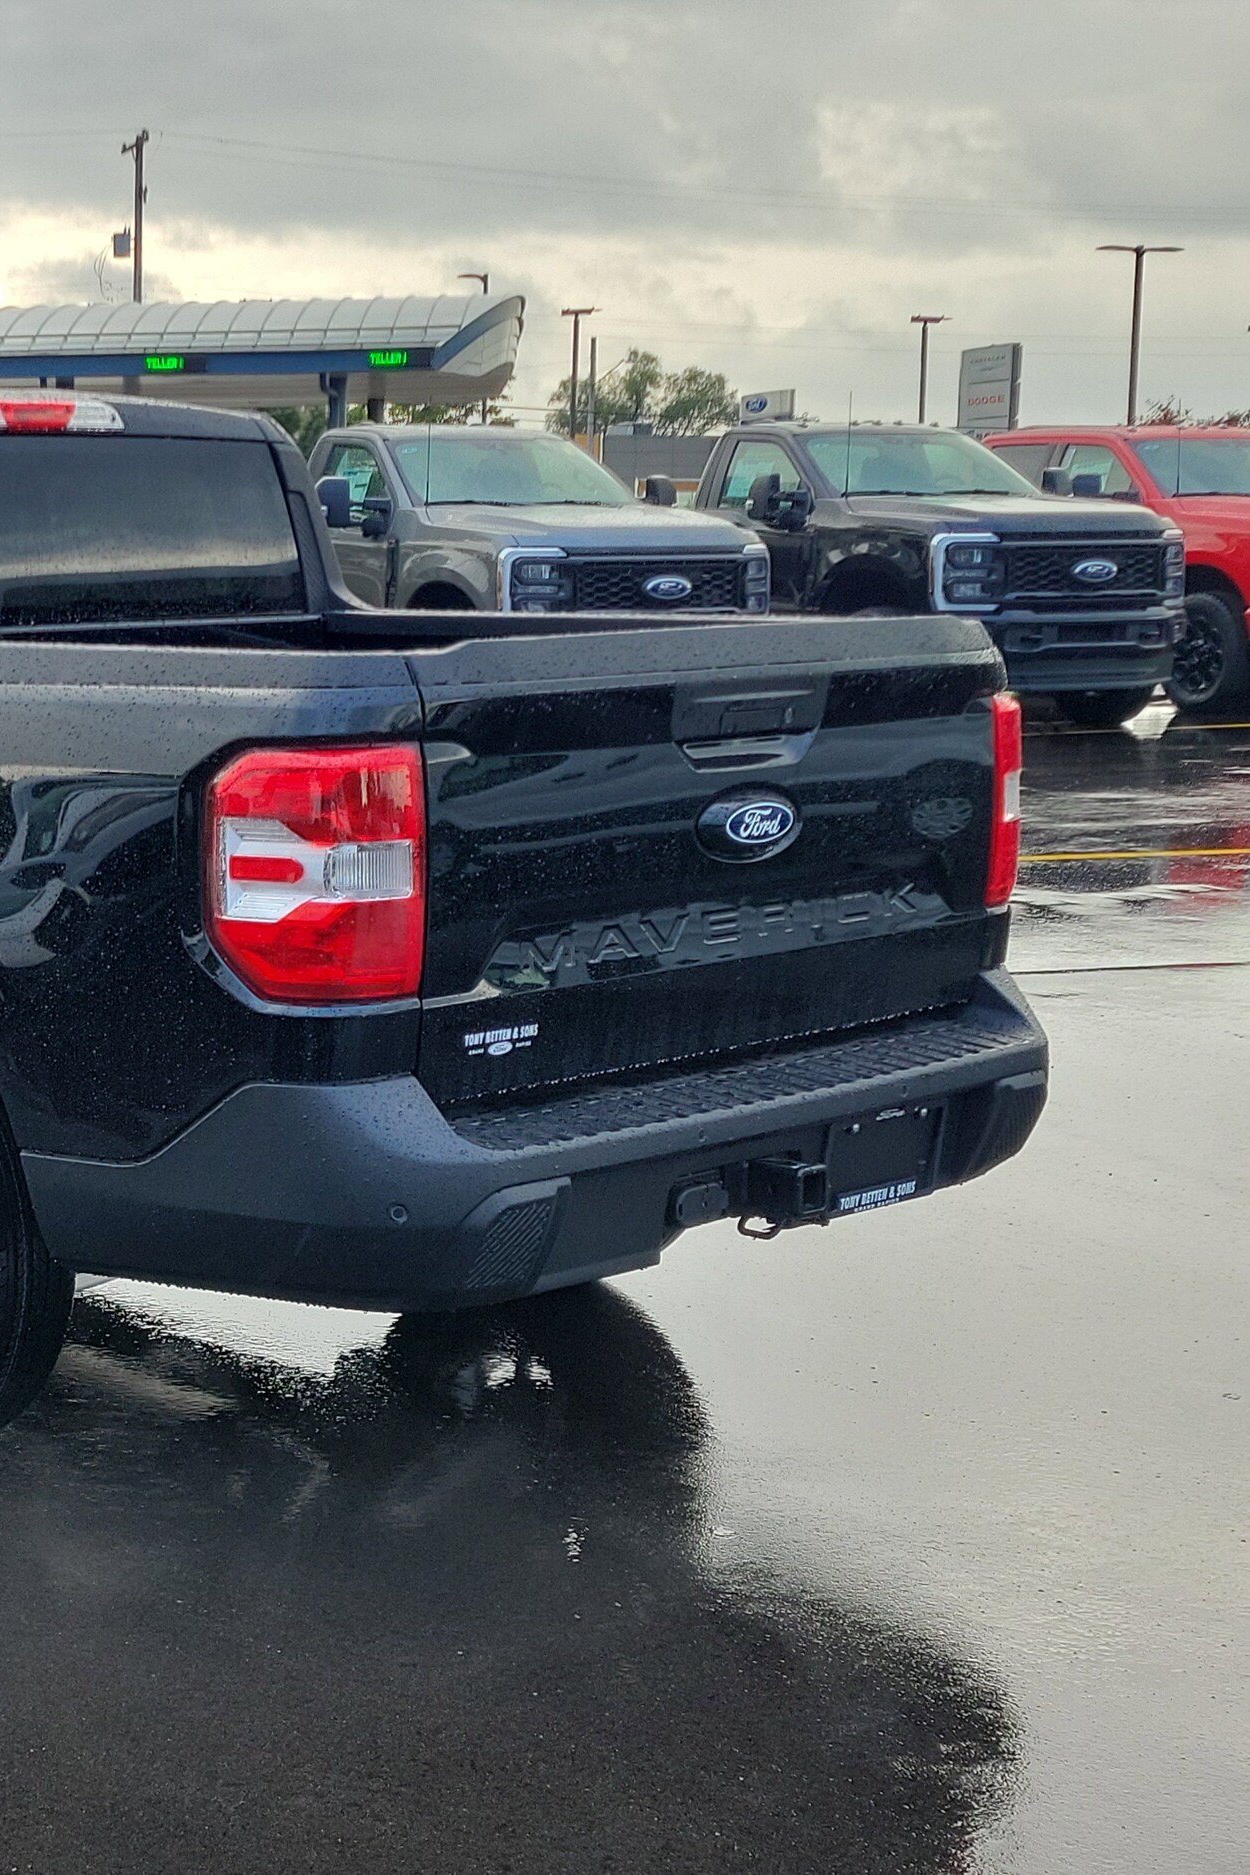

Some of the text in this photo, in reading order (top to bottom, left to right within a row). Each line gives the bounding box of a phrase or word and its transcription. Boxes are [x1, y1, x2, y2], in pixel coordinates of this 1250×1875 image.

[968, 394, 1005, 407] DODGE
[739, 808, 781, 838] Ford
[521, 883, 916, 972] MAVERICK
[464, 1032, 485, 1047] TONY
[520, 1023, 539, 1038] SONS
[840, 1180, 916, 1210] TONY BETTEN & SONS
